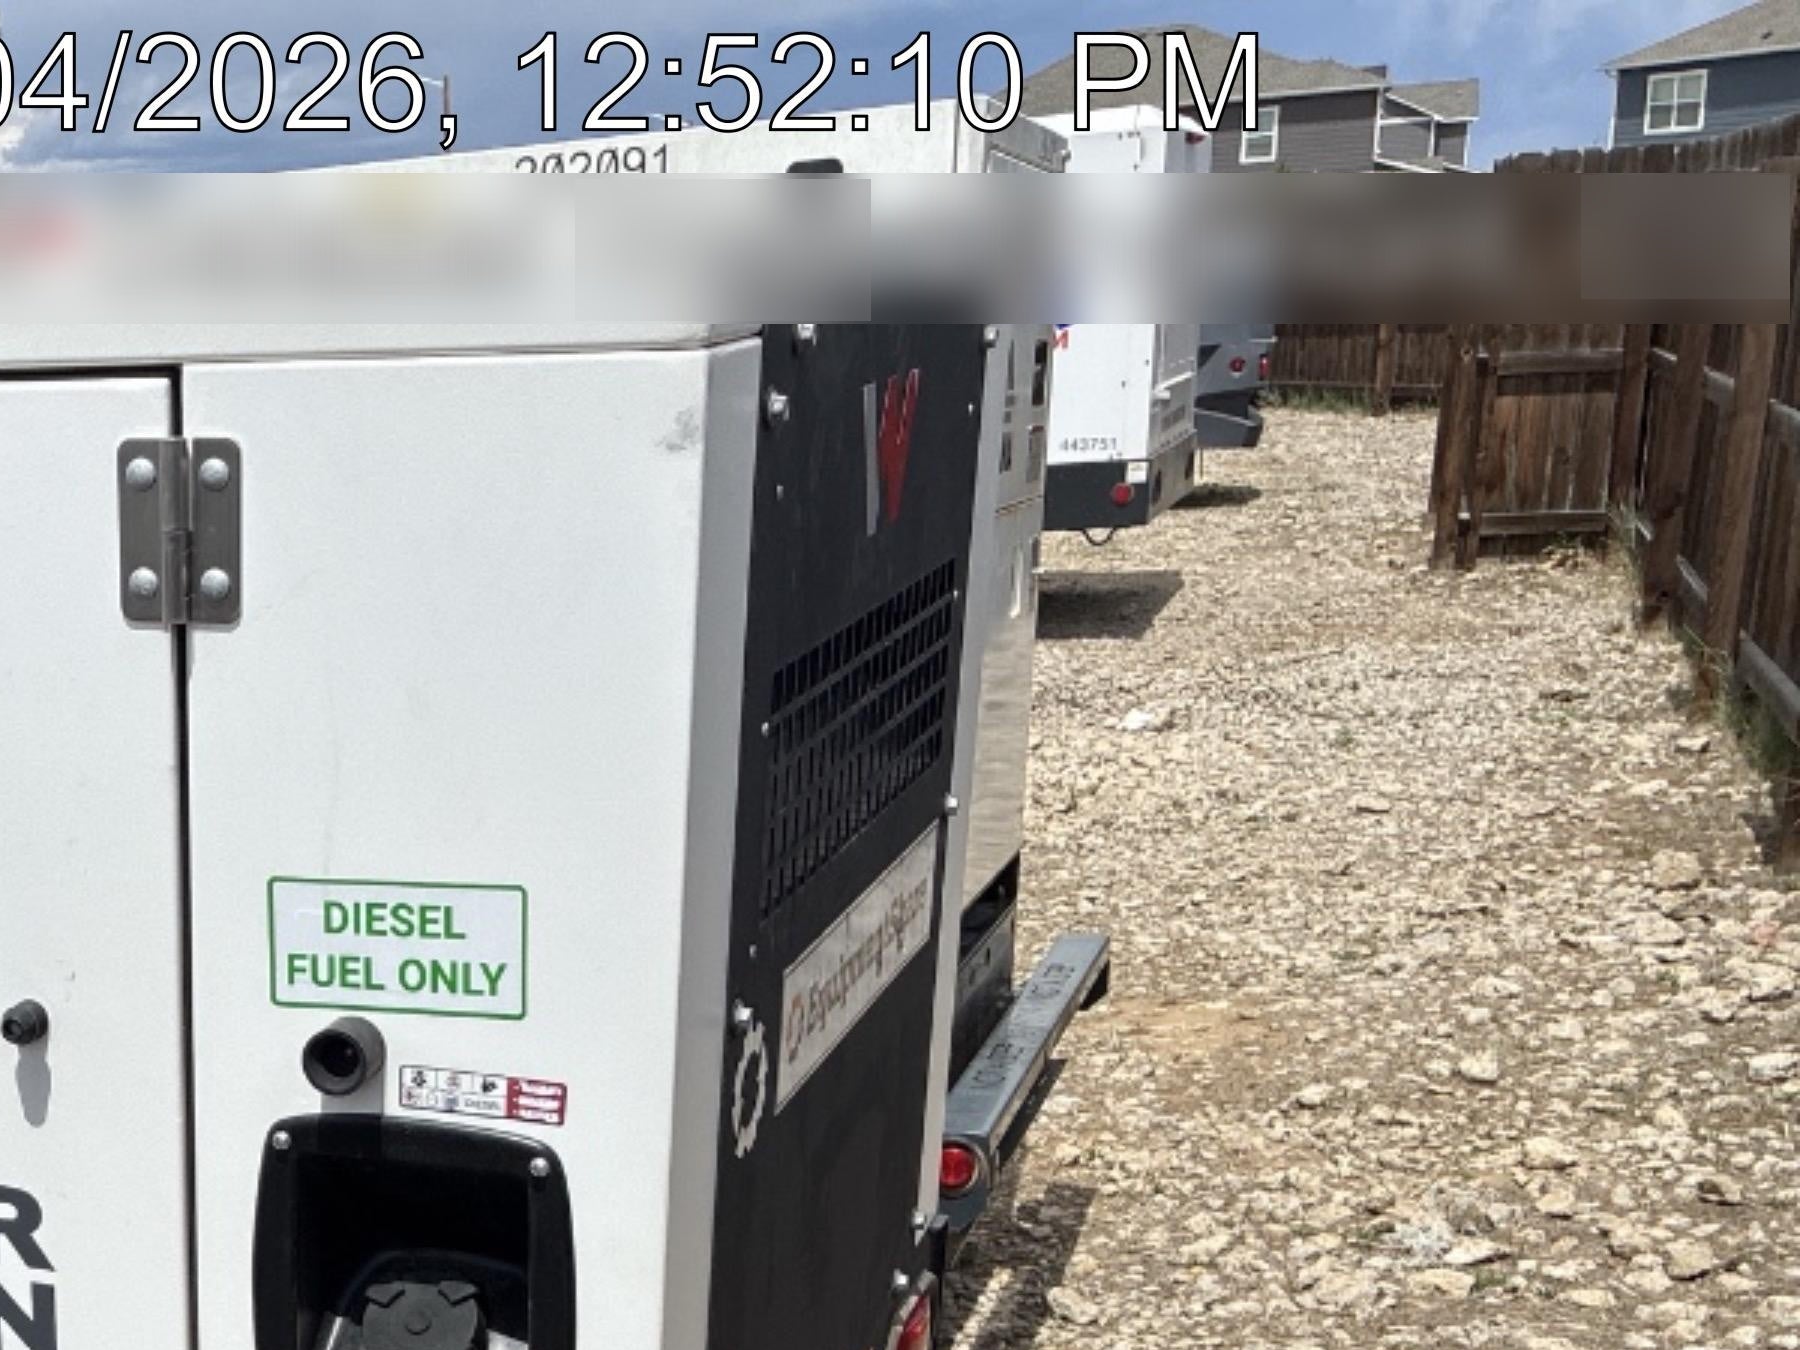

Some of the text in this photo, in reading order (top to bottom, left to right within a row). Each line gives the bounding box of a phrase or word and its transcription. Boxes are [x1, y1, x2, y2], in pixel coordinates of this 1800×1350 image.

[322, 900, 467, 940] DIESEL
[286, 952, 507, 997] FUEL ONLY
